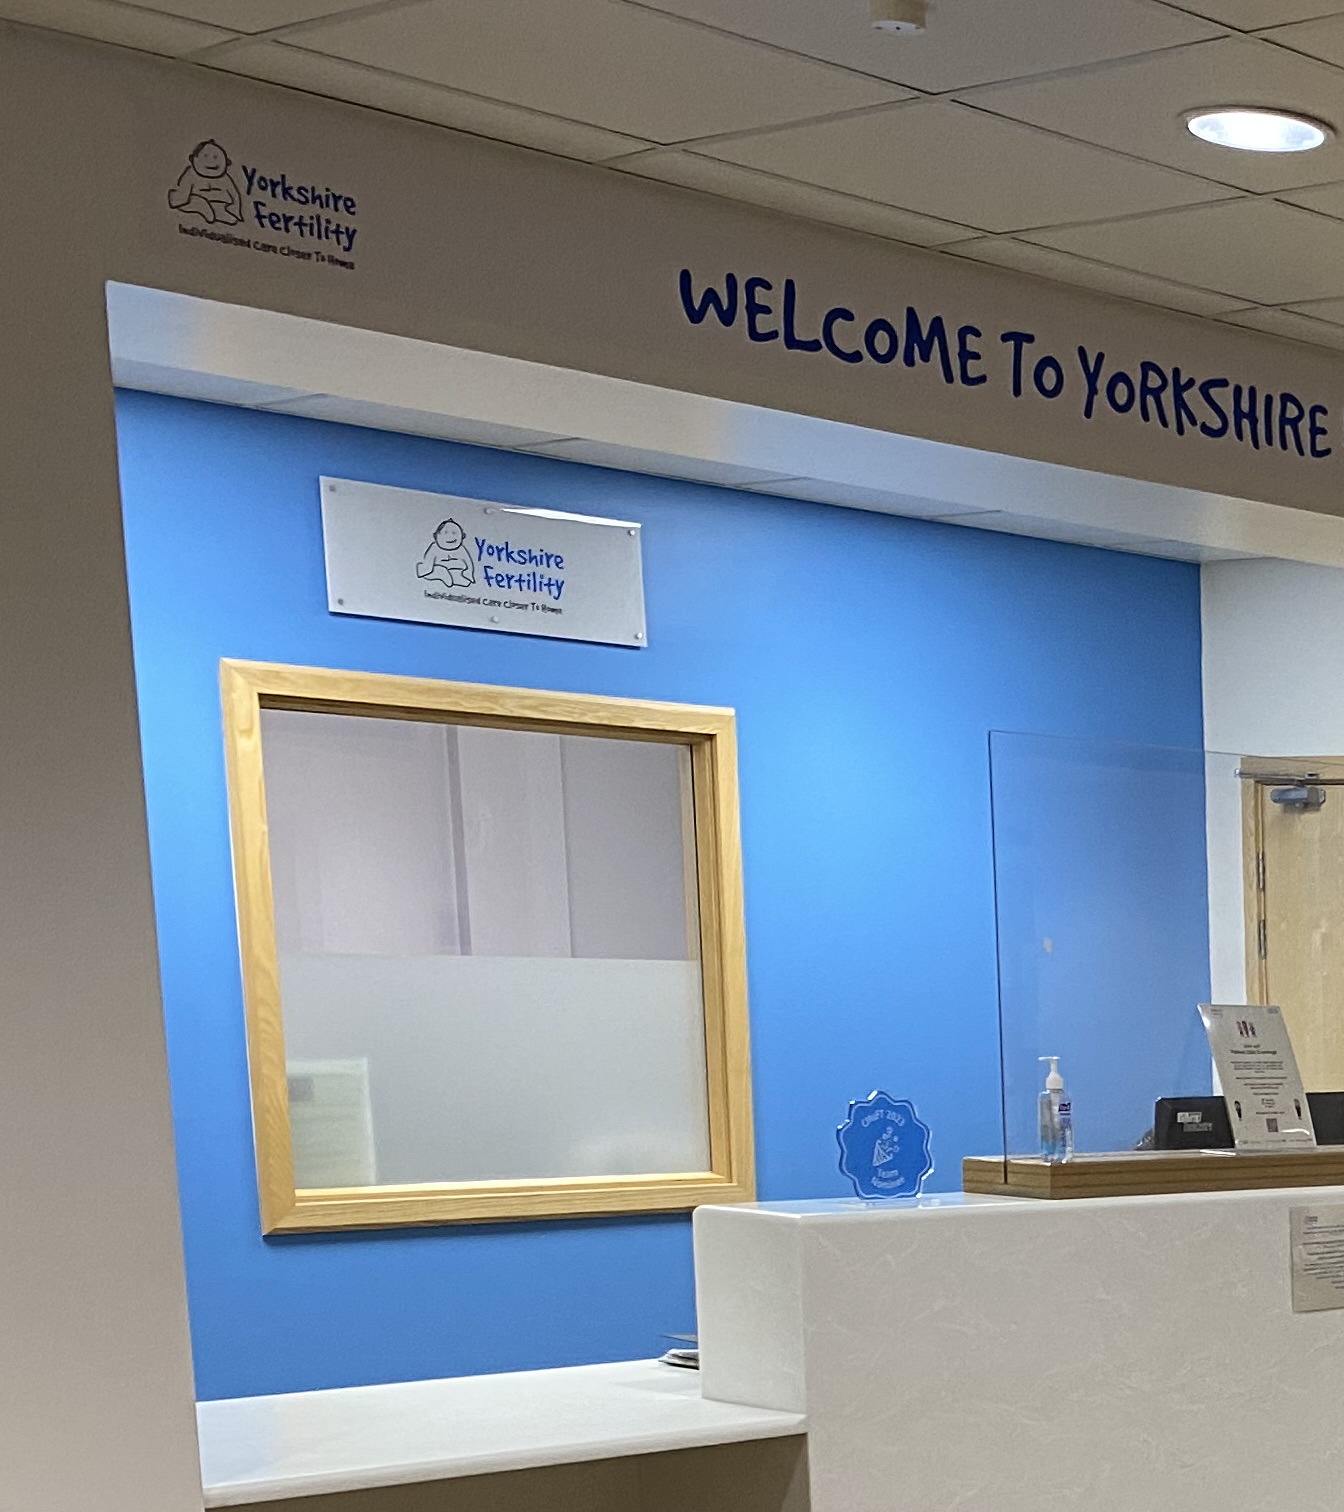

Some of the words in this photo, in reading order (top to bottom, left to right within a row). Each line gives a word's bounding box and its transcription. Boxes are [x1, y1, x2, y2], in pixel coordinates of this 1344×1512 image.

[242, 165, 356, 215] Yorkshire
[253, 201, 357, 252] Fertility
[679, 268, 987, 387] WELCOME
[1078, 345, 1332, 460] YORKSHIRE
[474, 536, 565, 570] Yorkshire
[483, 565, 565, 601] Fertility
